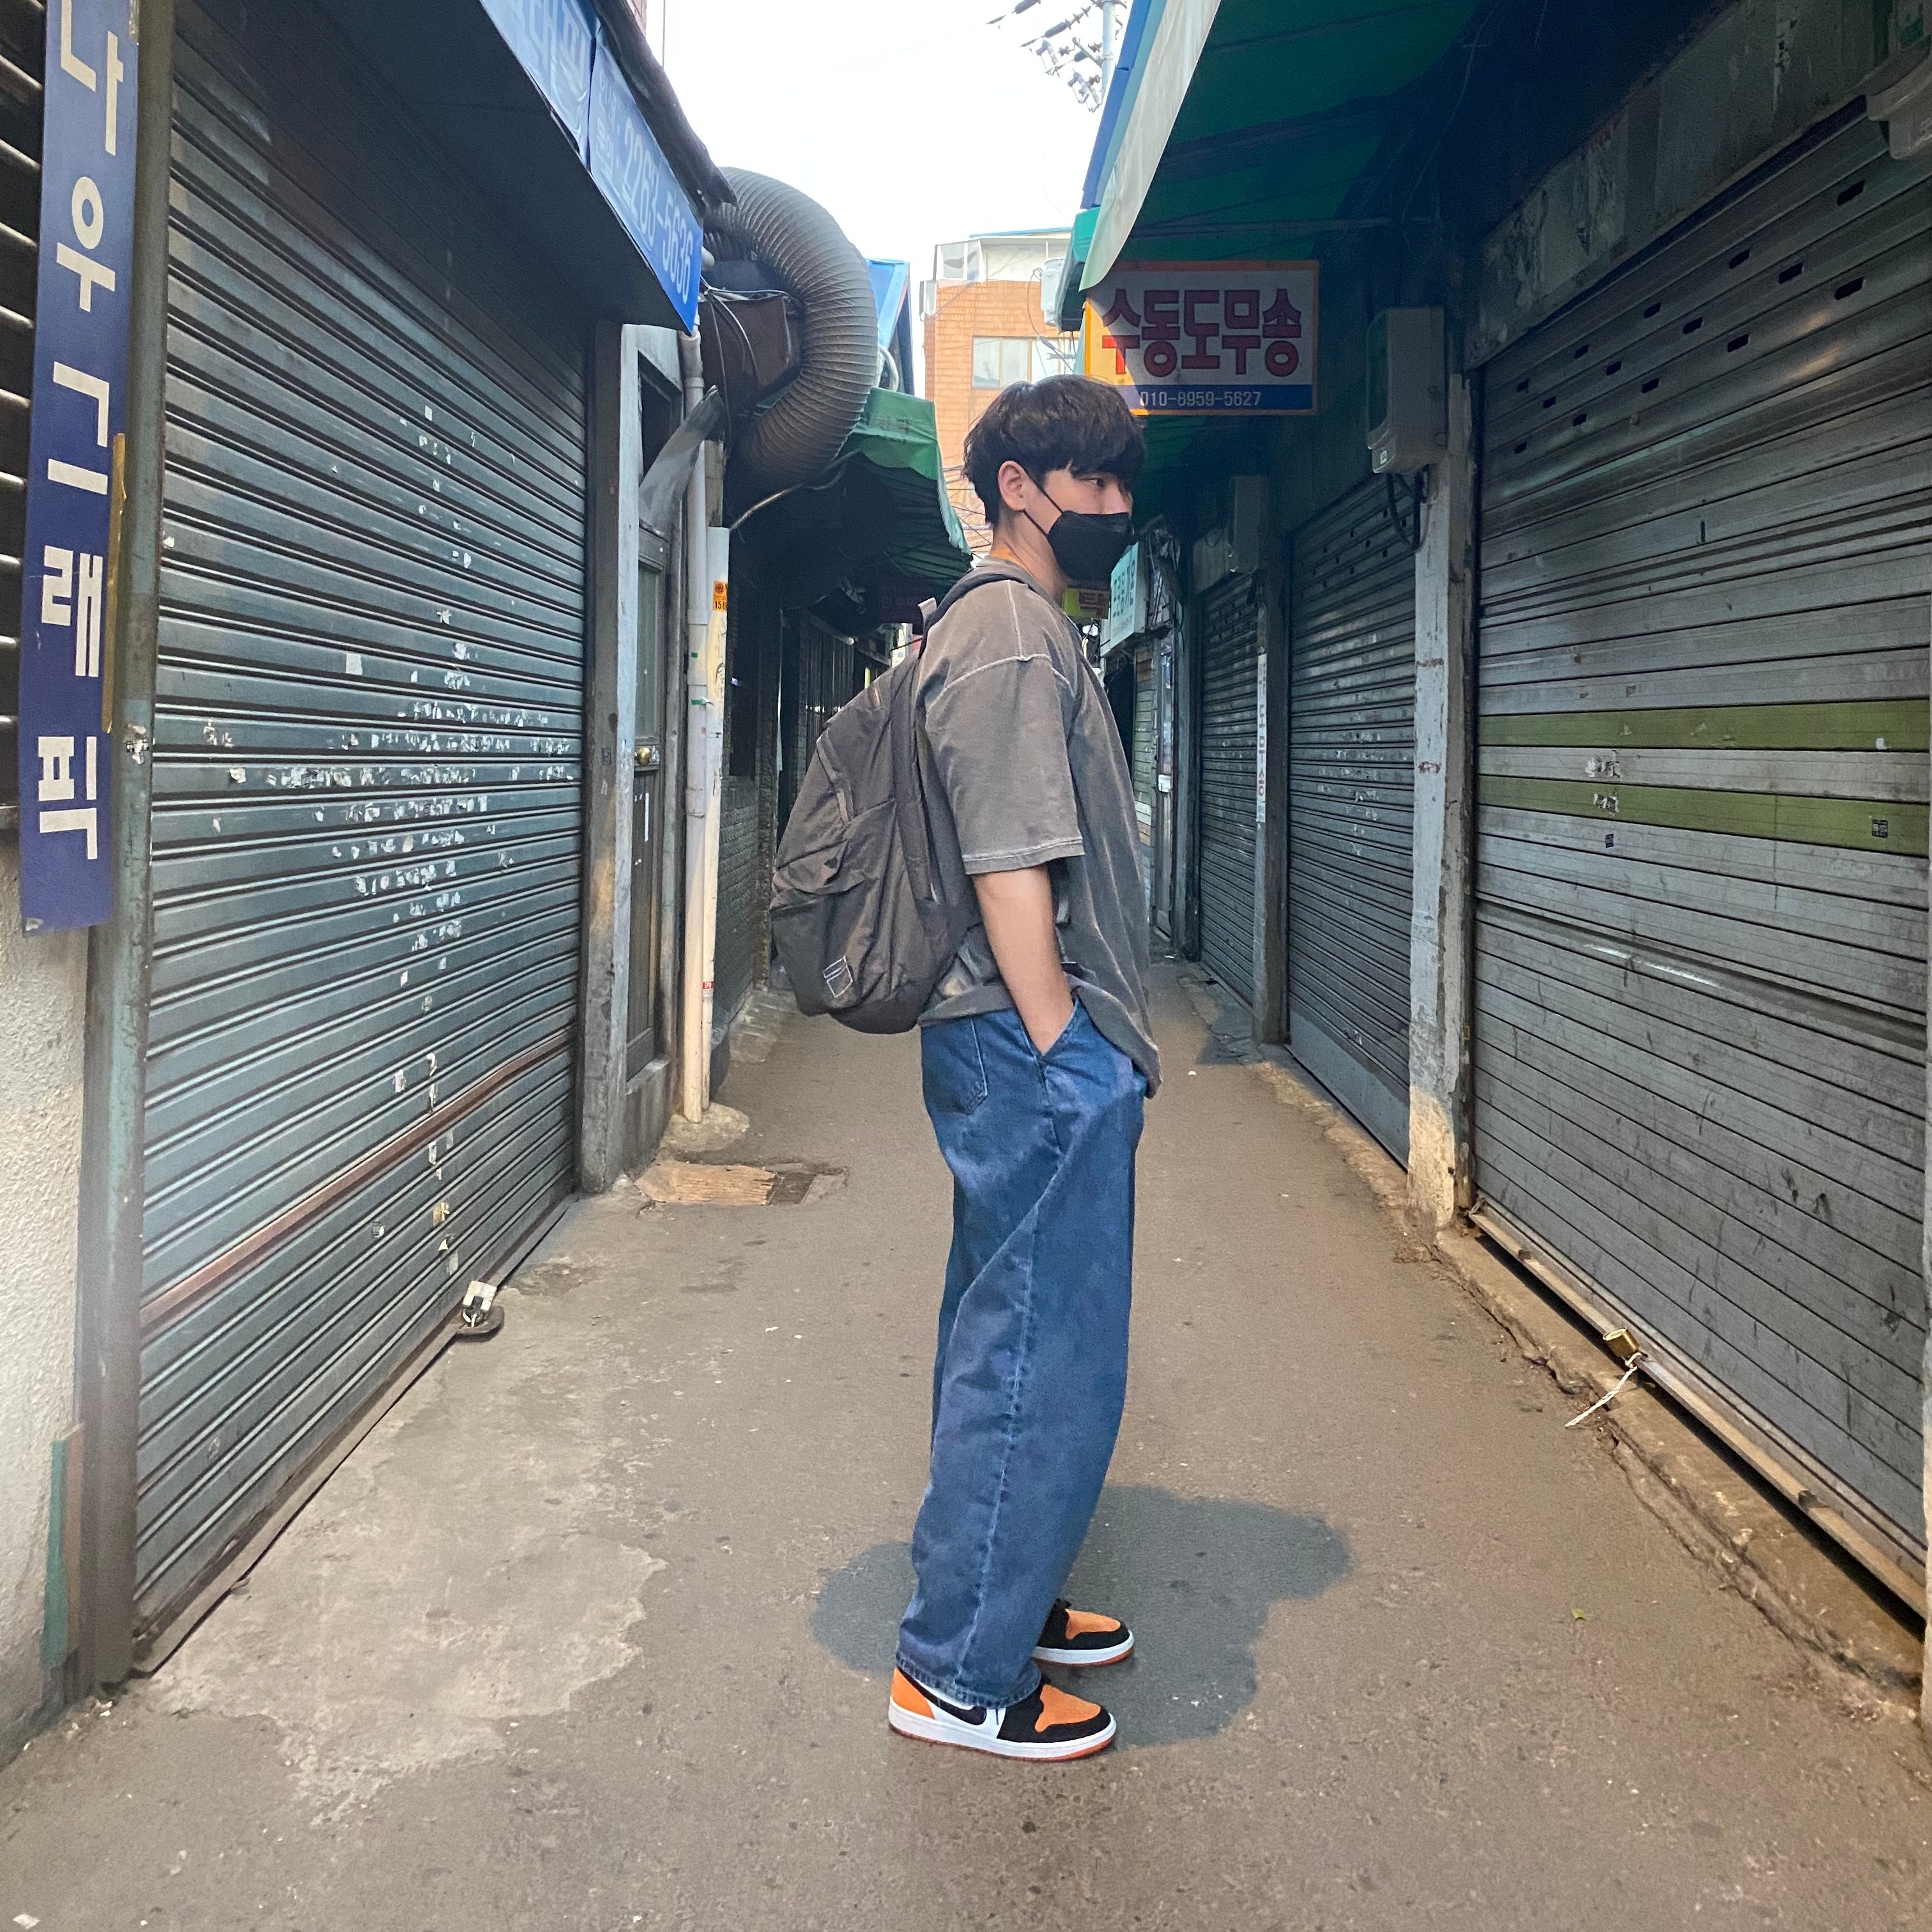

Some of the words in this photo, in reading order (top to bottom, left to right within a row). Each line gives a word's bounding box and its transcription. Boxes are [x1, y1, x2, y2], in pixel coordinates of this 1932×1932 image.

[623, 117, 693, 305] 2263-5636
[1102, 288, 1302, 377] 수동도무송
[1140, 391, 1261, 407] 010-8959-5627
